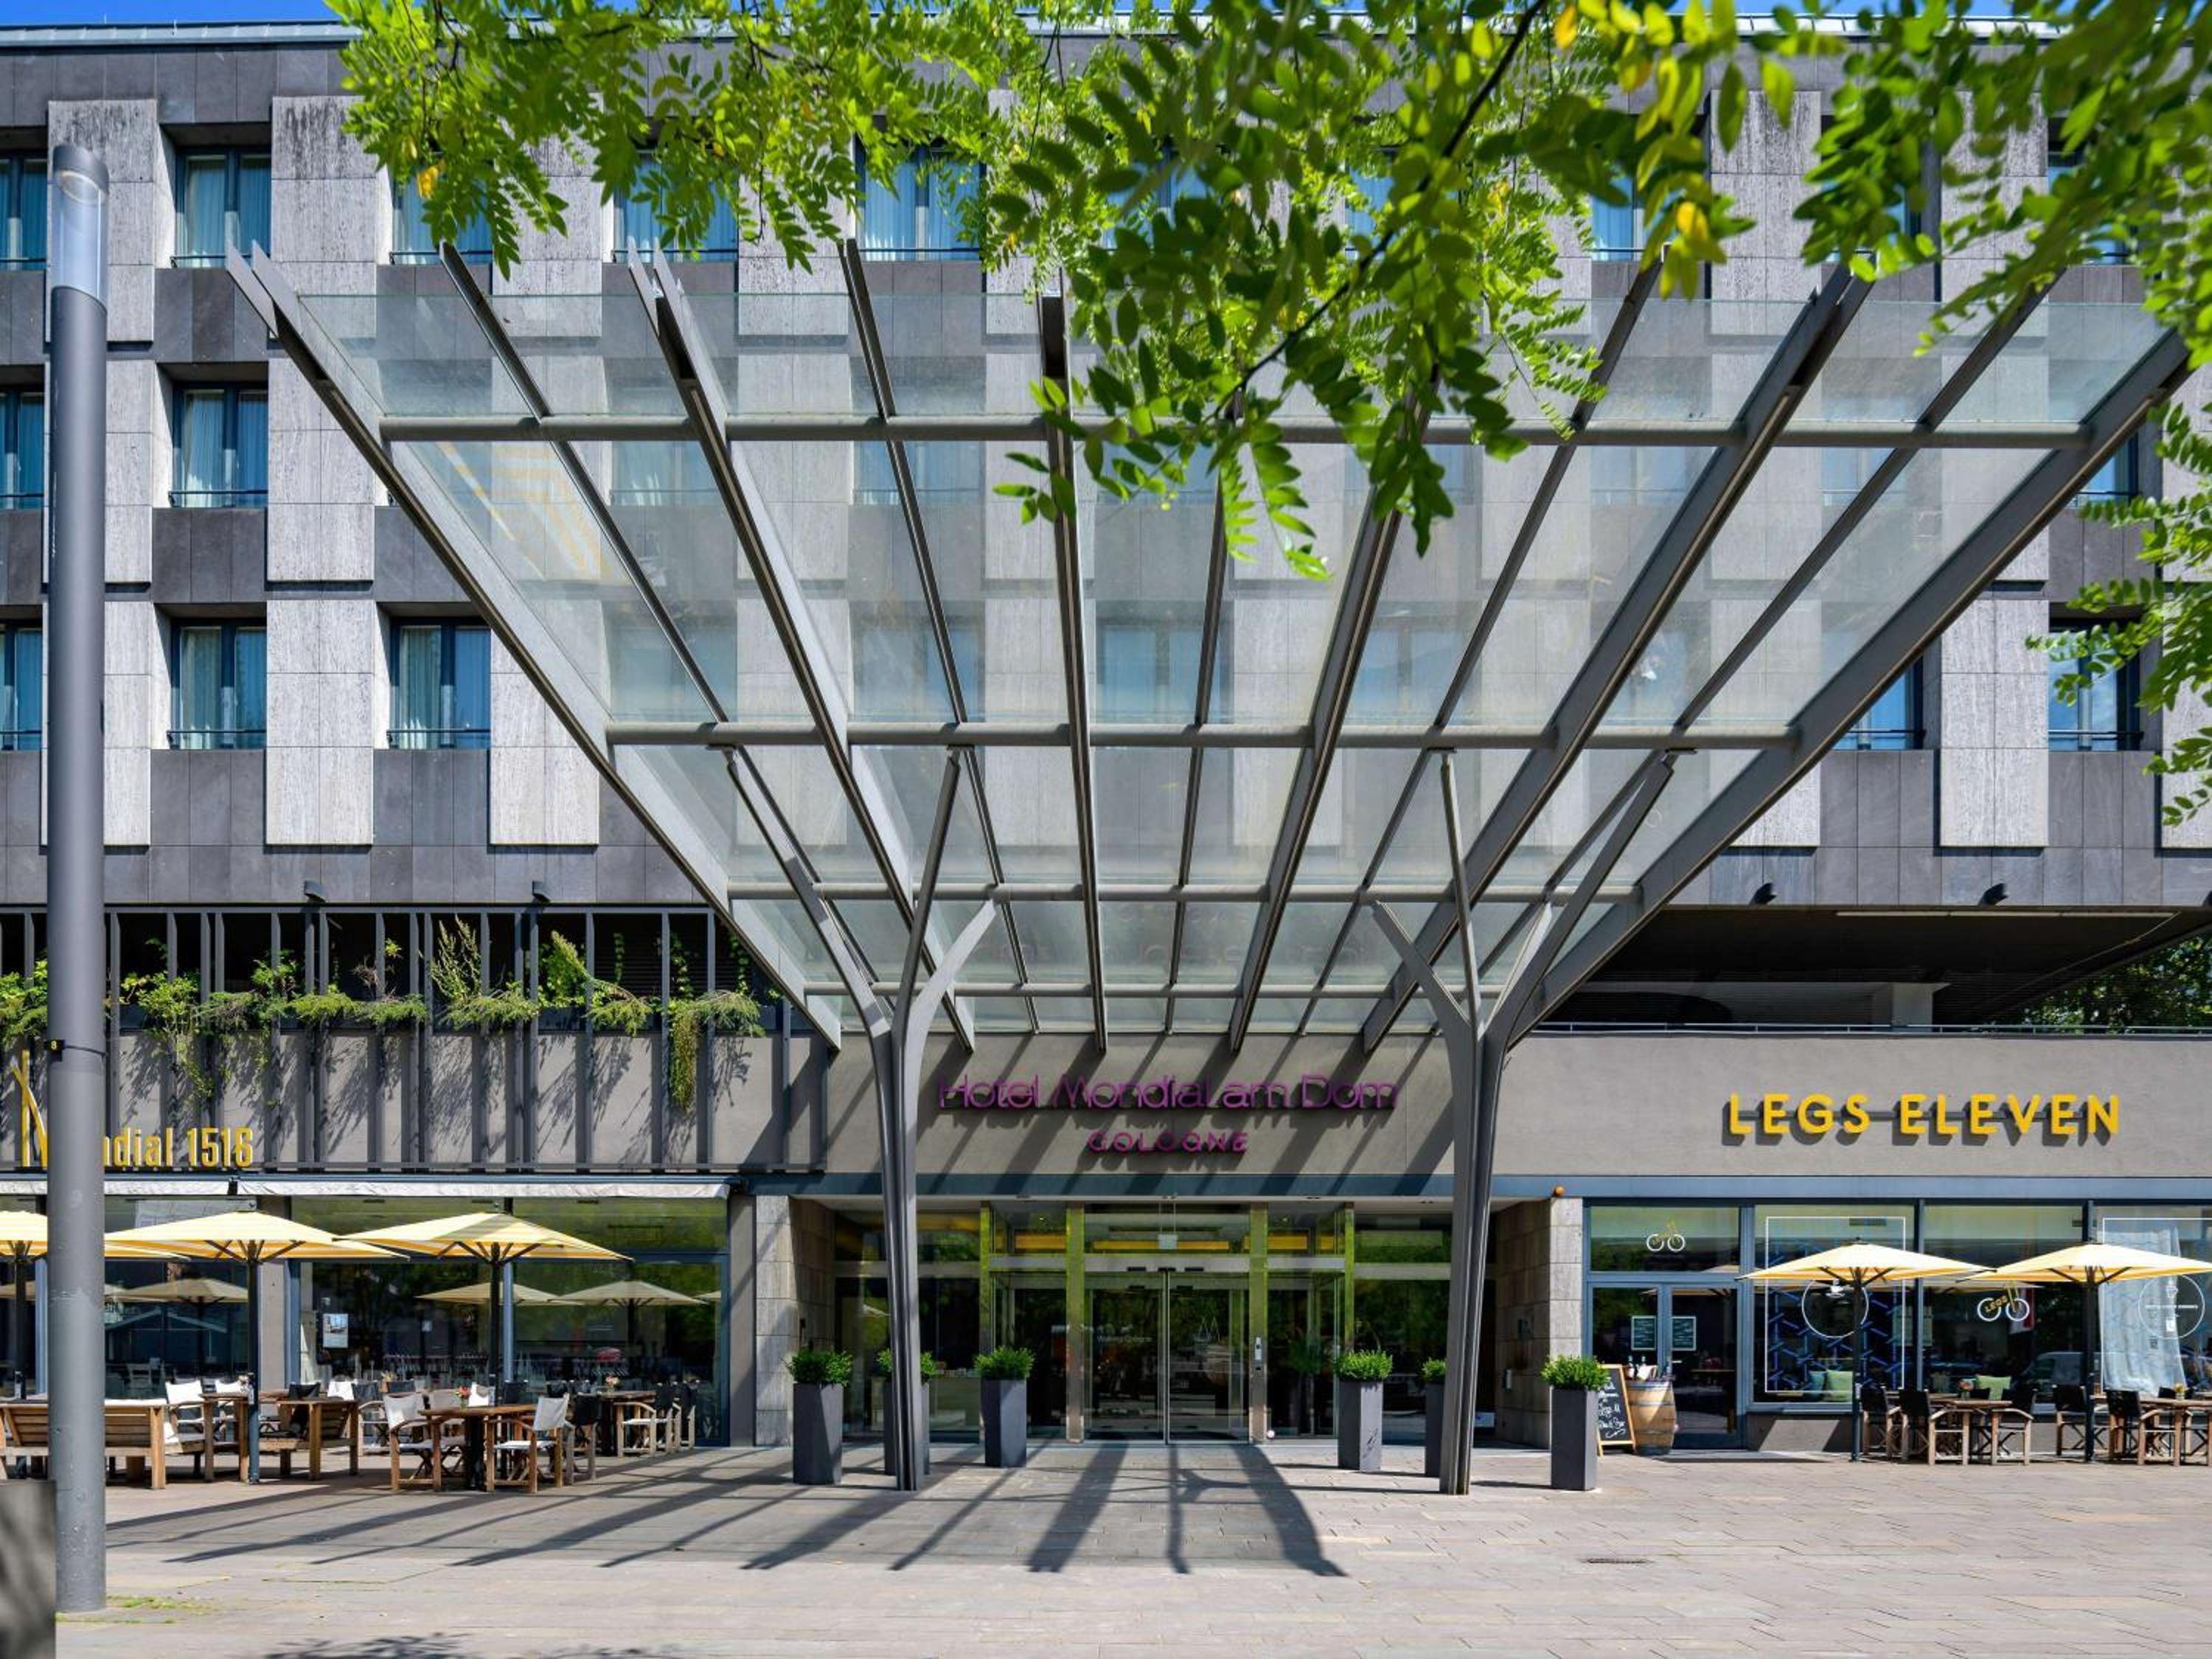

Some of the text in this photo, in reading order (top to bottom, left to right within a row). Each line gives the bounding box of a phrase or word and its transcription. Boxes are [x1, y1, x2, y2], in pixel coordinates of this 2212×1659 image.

[50, 1040, 58, 1050] 8
[11, 1049, 253, 1167] Mdial 1516
[939, 1072, 1397, 1108] Hotel Mondial am Dom
[1730, 1093, 2119, 1133] LEGS ELEVEN
[1087, 1132, 1249, 1151] COLOGNE
